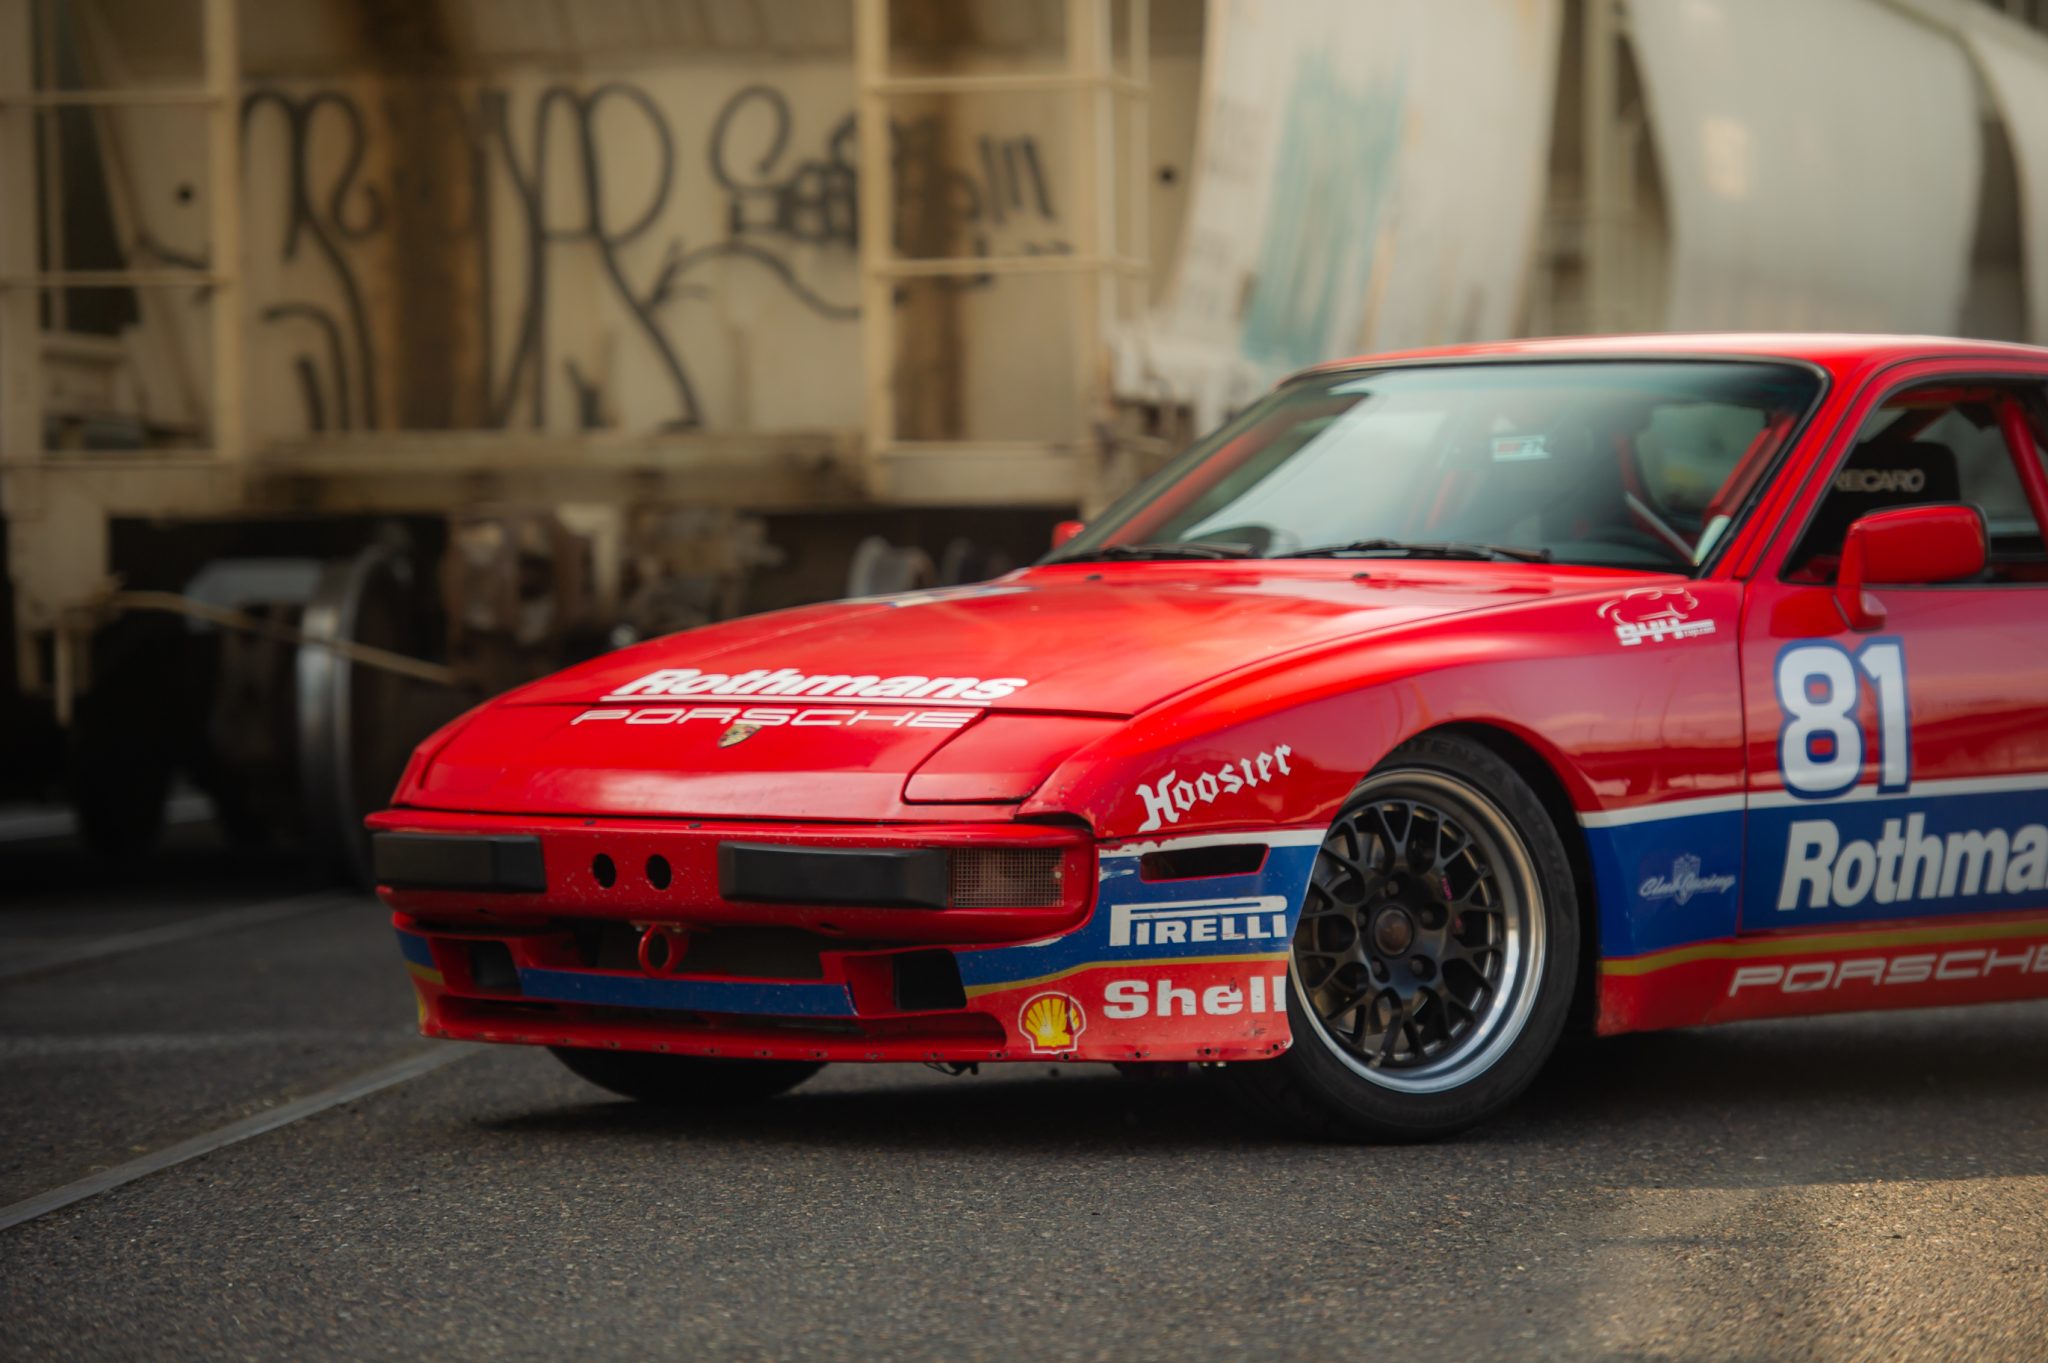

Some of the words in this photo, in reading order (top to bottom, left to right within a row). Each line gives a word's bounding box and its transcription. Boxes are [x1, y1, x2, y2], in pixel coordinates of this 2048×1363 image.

[611, 668, 1027, 699] Rothmans
[571, 707, 985, 728] PORSCHE
[1776, 637, 1911, 798] 81
[1136, 744, 1291, 832] Hoosier
[1777, 812, 2048, 912] Rothma
[1109, 896, 1288, 946] PIRELLI
[1103, 976, 1287, 1019] Shell
